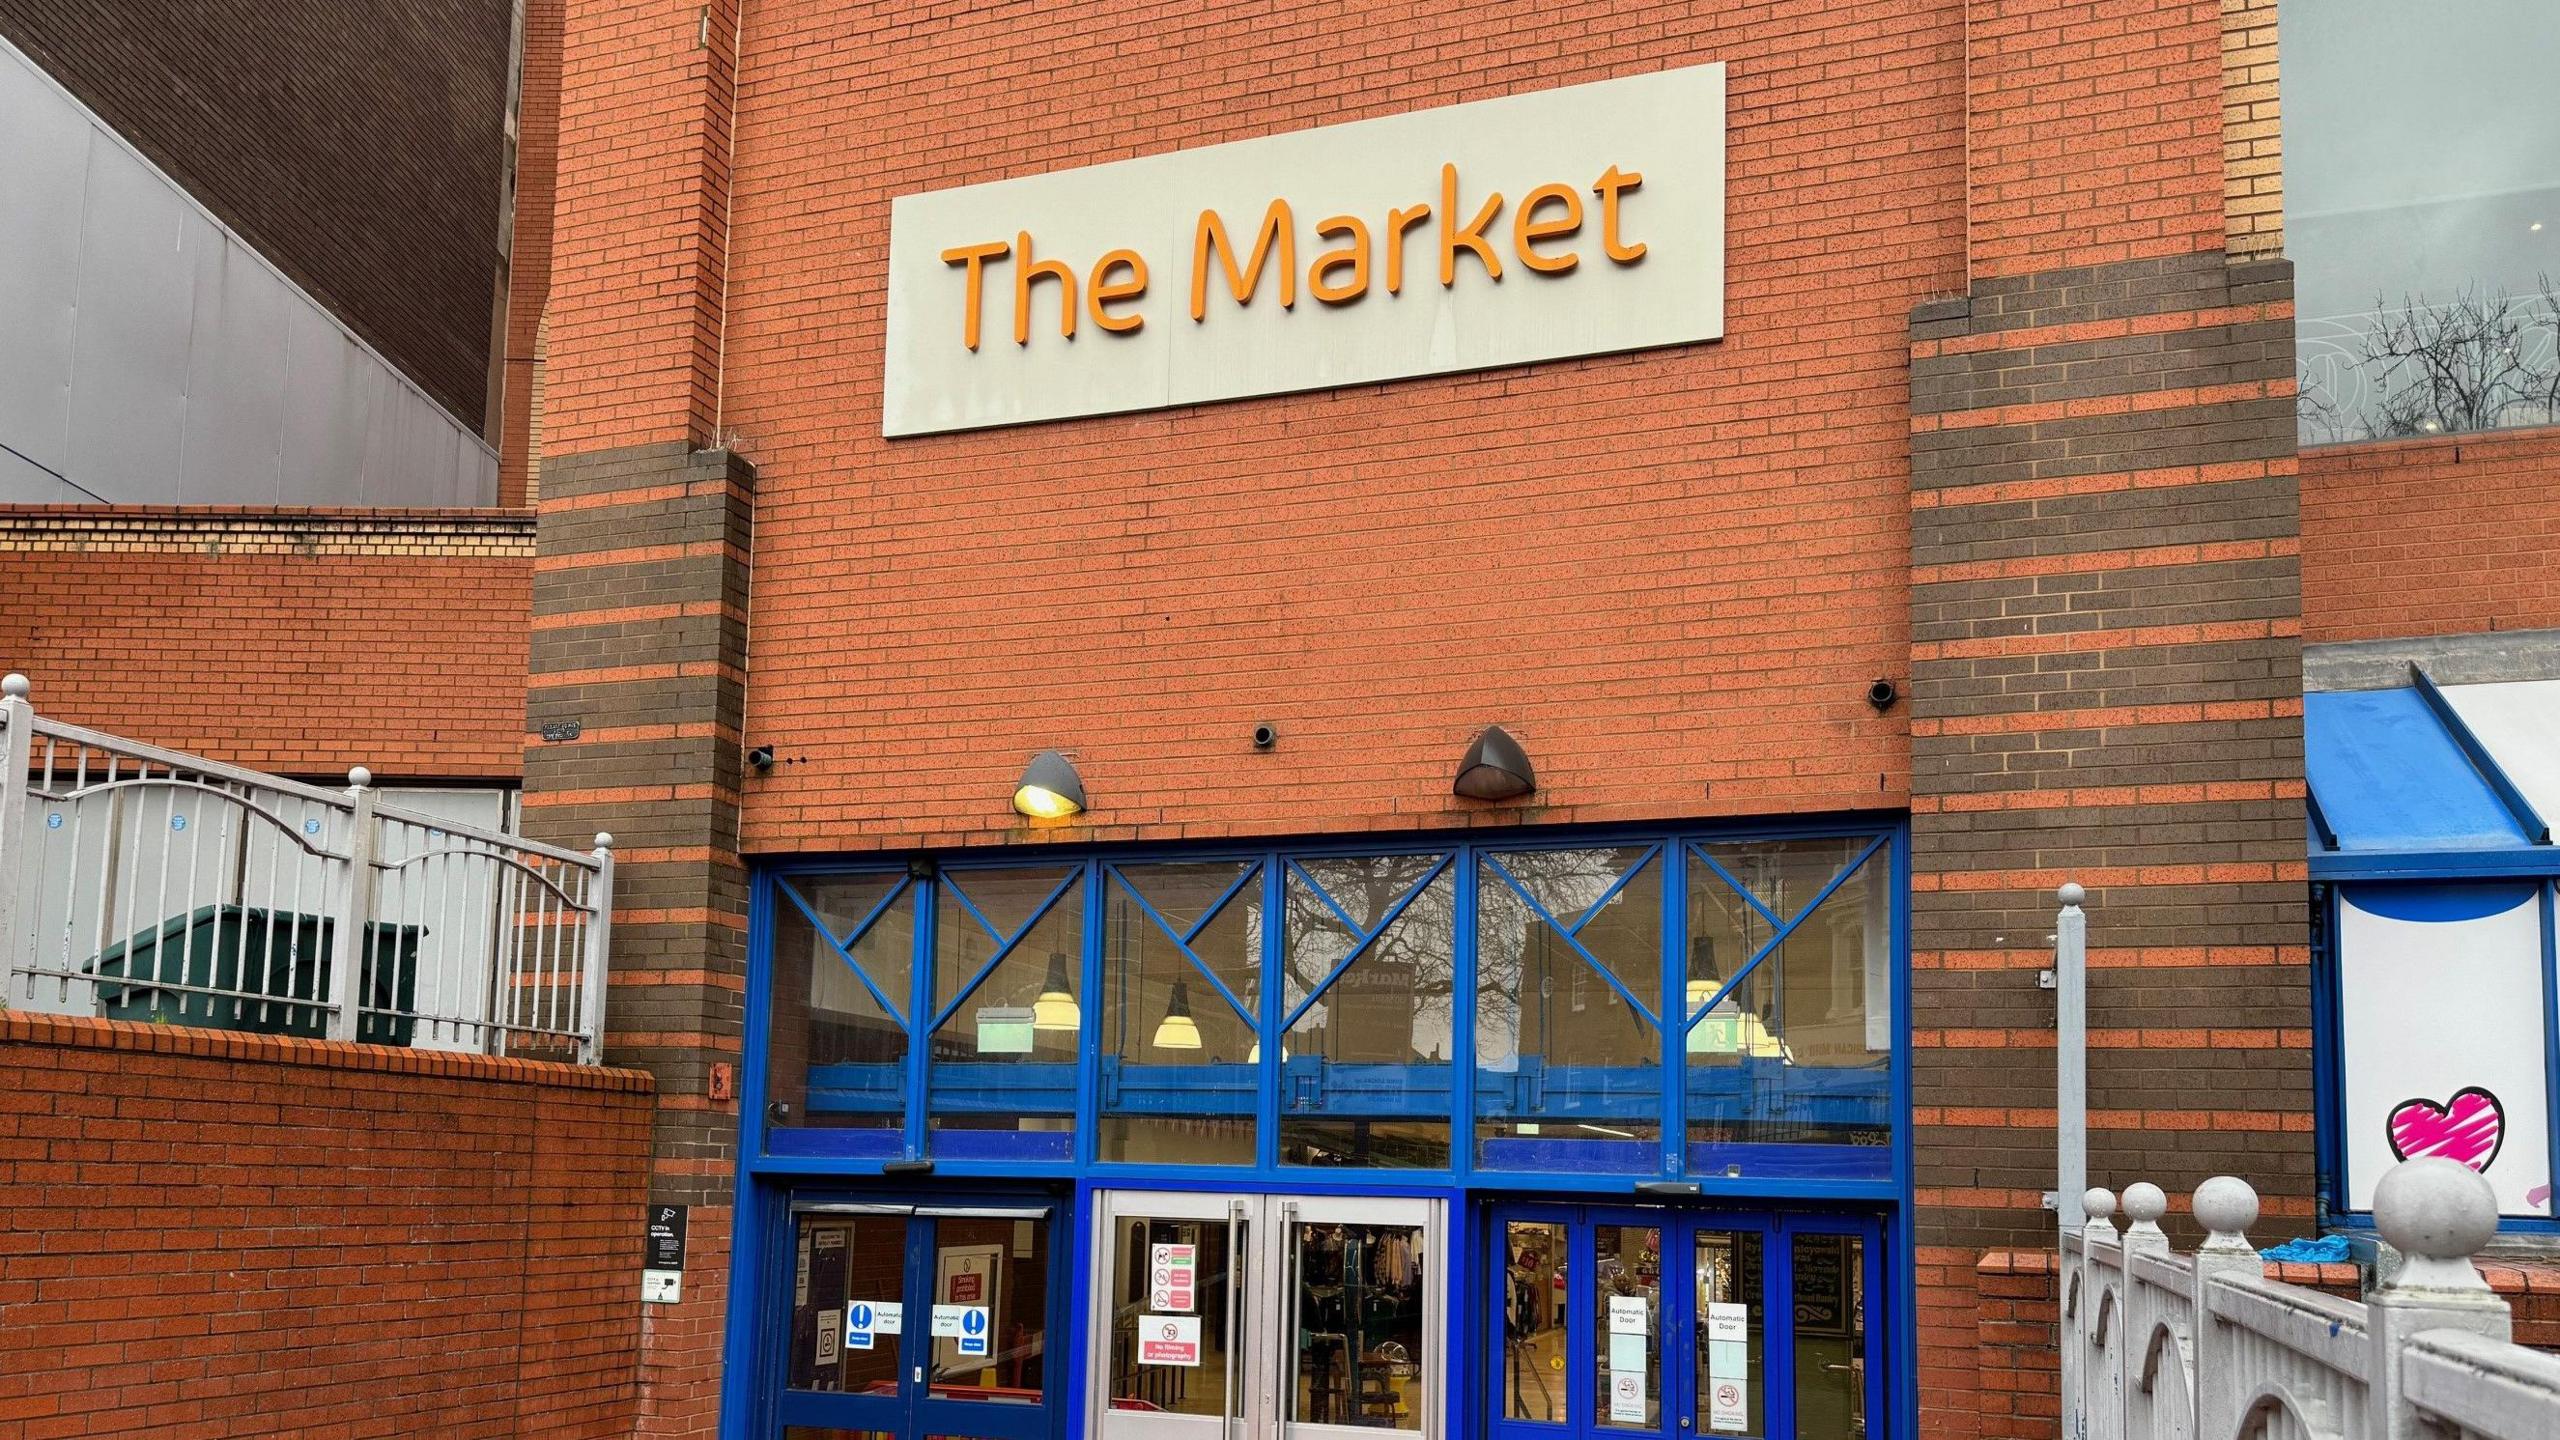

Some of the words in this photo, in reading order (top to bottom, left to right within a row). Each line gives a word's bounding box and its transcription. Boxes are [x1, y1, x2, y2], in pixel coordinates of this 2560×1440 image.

[941, 230, 1149, 351] The
[1190, 162, 1648, 324] Market
[1710, 1314, 1745, 1322] Automatic
[1164, 1344, 1185, 1352] filming
[1154, 1352, 1192, 1361] photography
